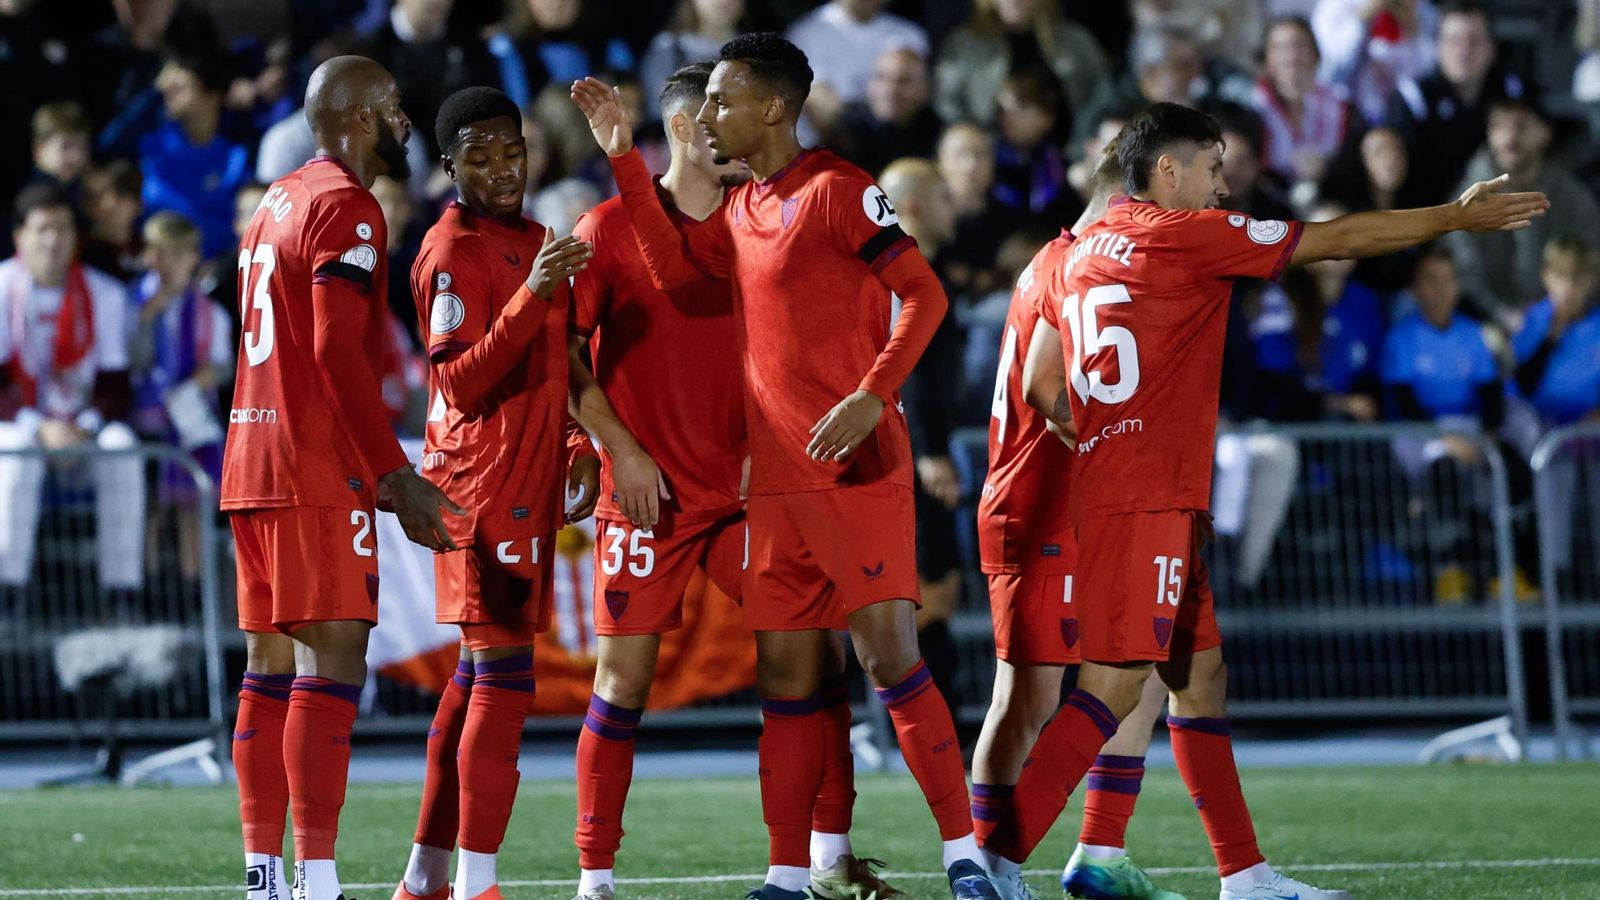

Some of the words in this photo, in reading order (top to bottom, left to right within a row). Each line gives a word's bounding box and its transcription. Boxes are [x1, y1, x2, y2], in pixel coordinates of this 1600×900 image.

[1062, 284, 1140, 407] 15
[602, 526, 655, 578] 35
[1153, 555, 1183, 607] 15
